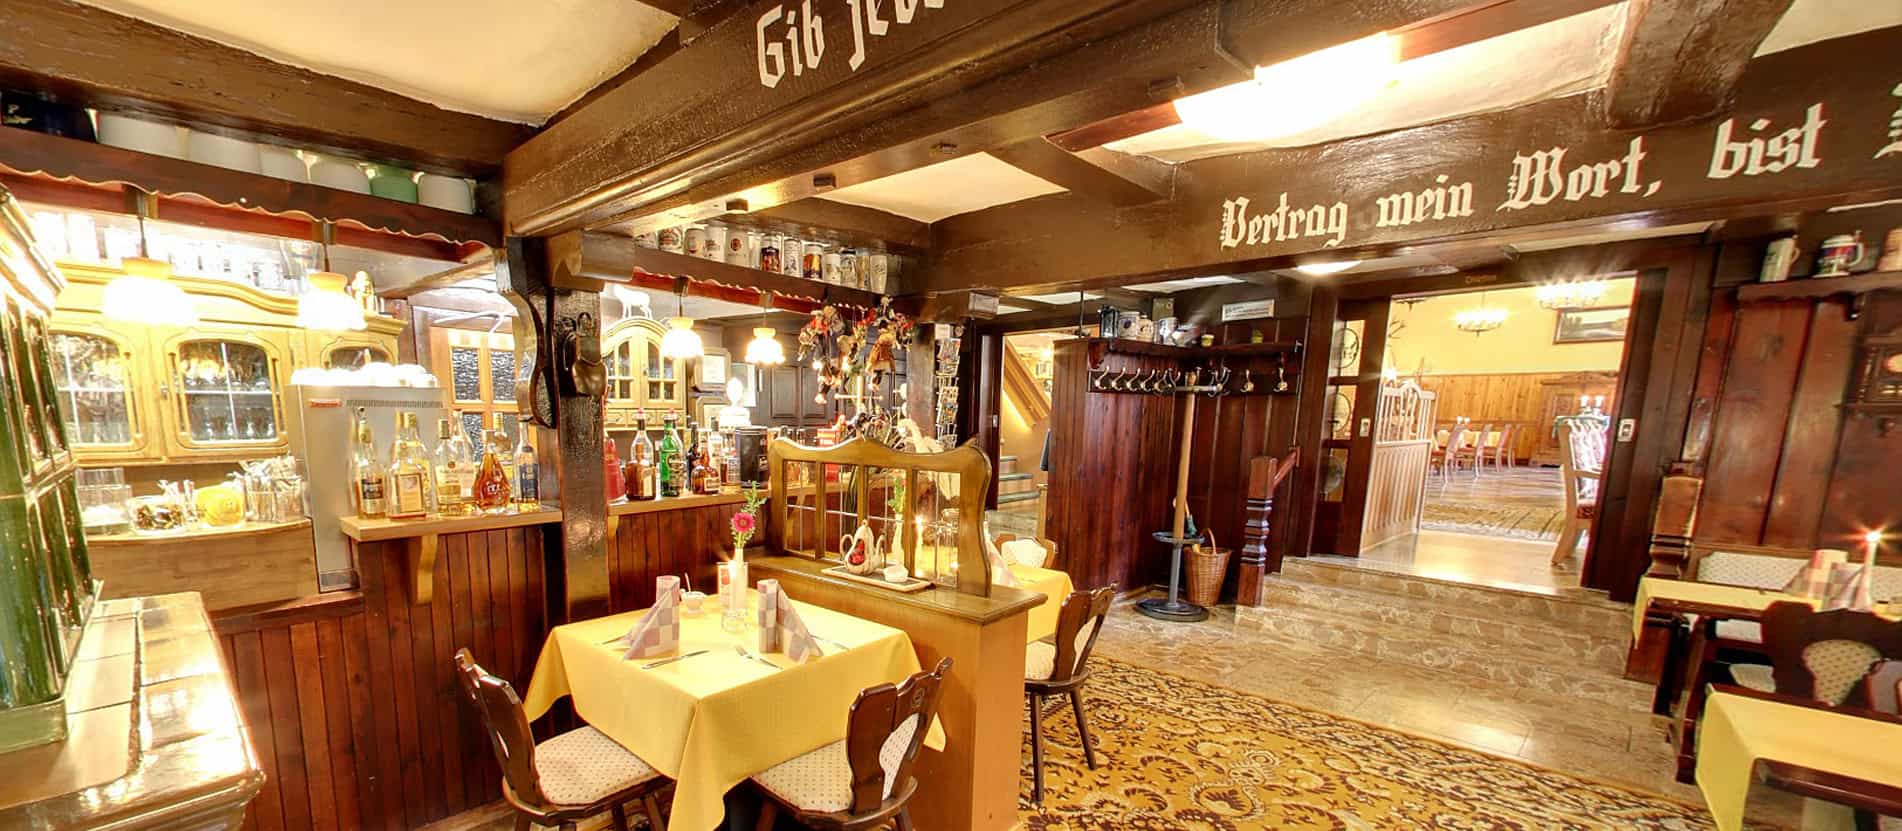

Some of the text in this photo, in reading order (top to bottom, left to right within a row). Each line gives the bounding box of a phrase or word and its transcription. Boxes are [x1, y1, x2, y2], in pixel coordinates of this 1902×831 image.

[757, 0, 825, 88] Gib
[1220, 192, 1349, 250] Vertrag
[1376, 176, 1474, 227] mein
[1496, 135, 1662, 212] Wort,
[1707, 102, 1827, 179] bist
